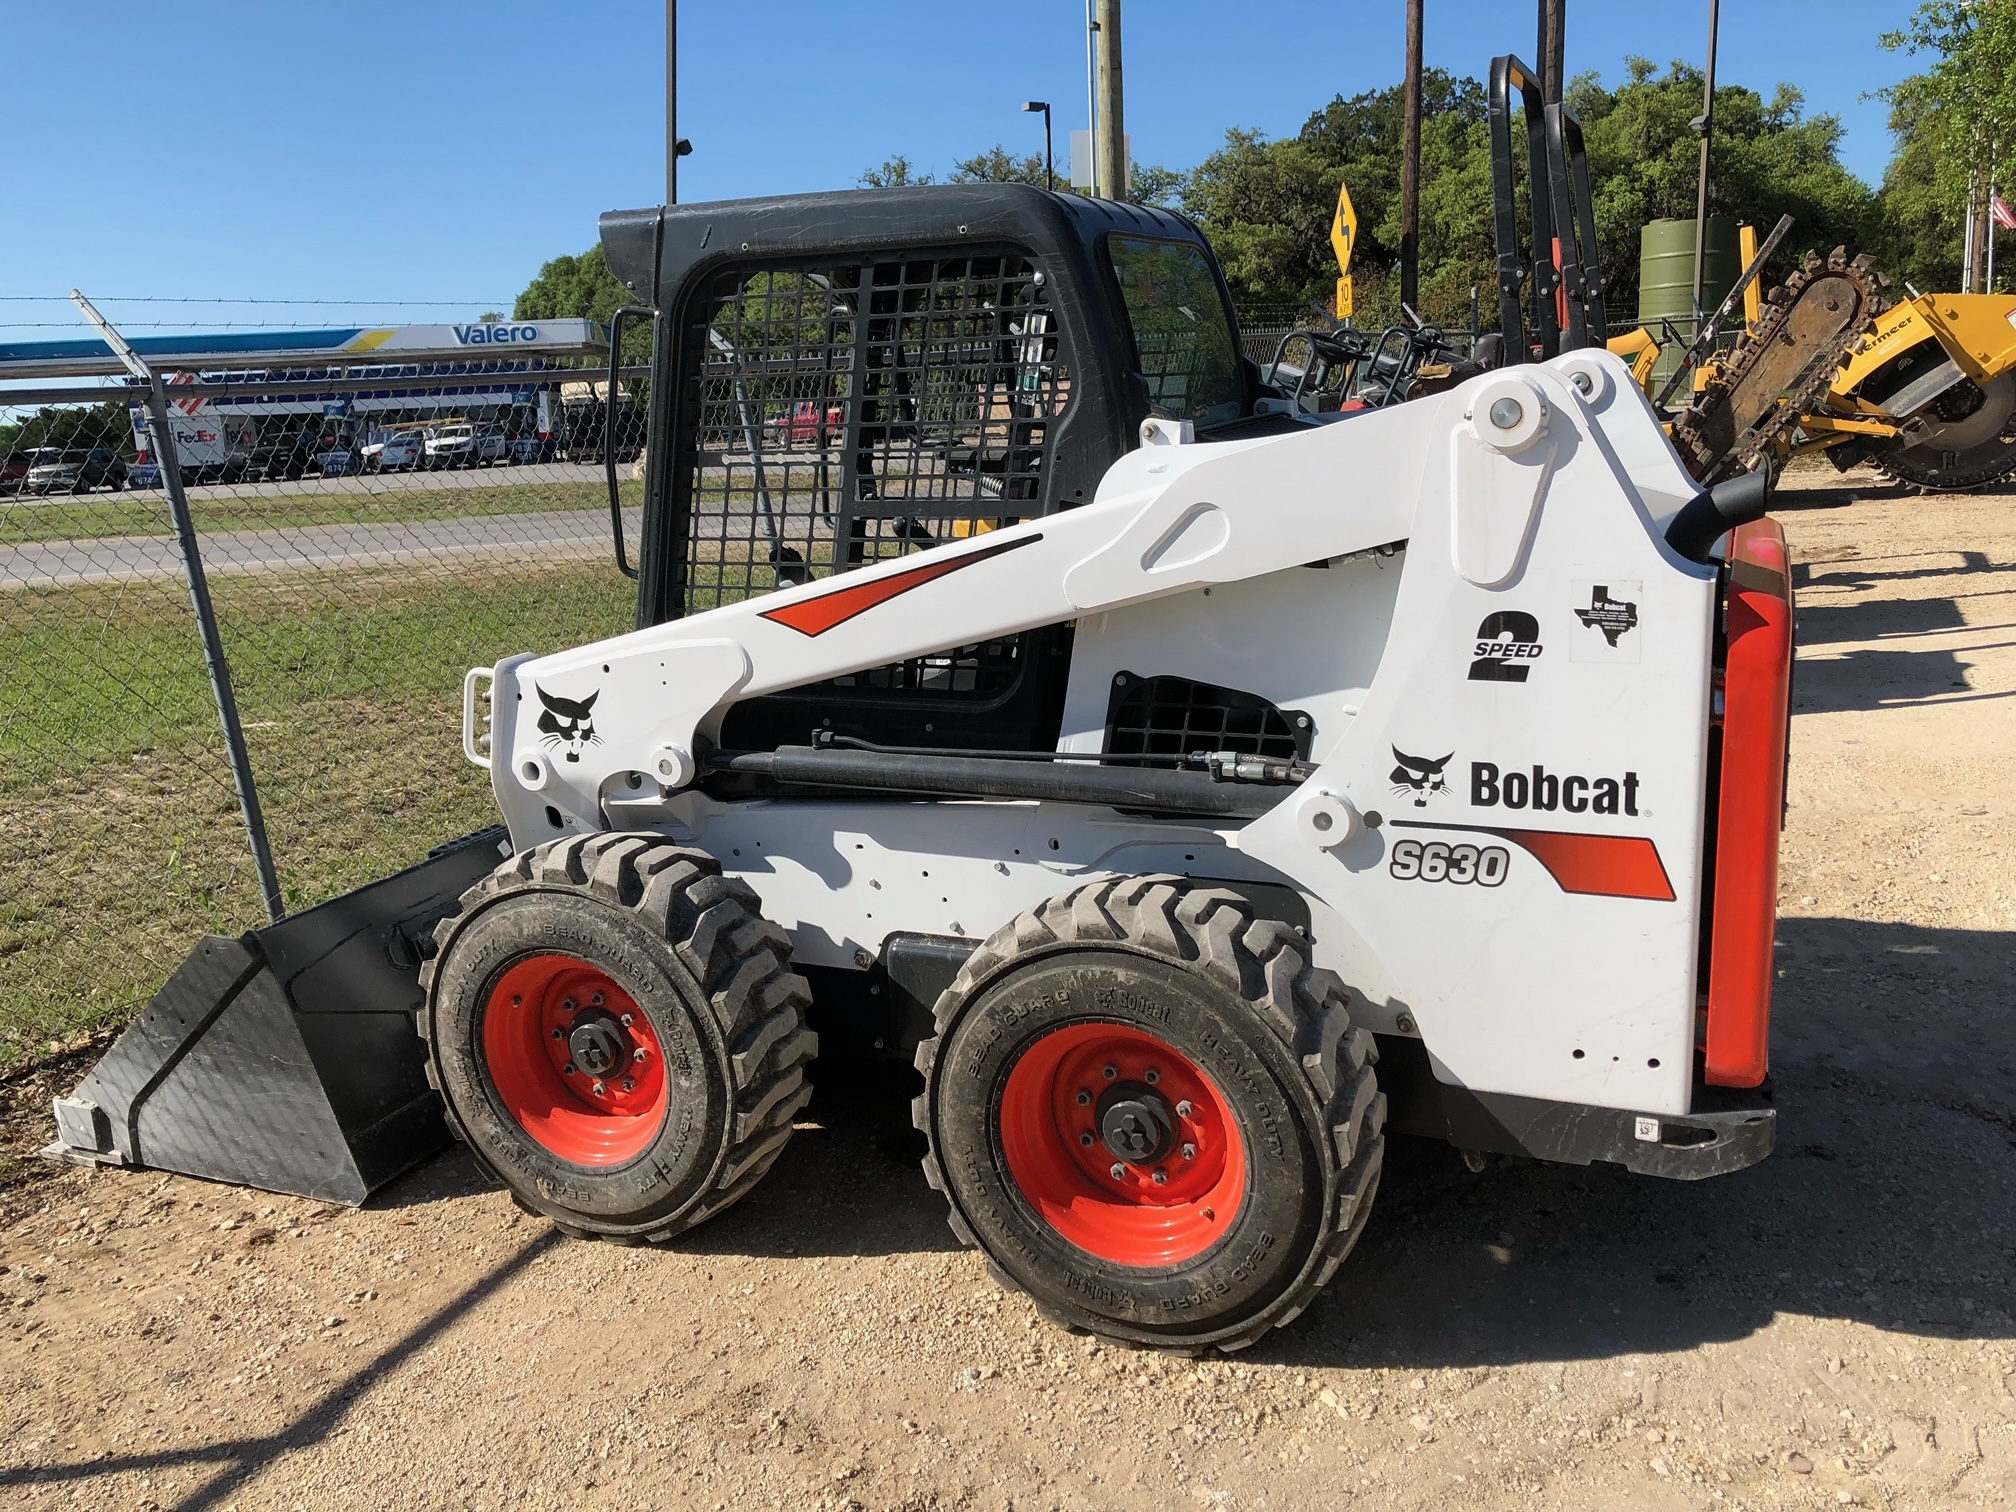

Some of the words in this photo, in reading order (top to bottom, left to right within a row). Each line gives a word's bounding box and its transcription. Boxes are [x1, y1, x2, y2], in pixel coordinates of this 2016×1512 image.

[1340, 283, 1349, 303] 10
[452, 324, 537, 345] Valero
[176, 429, 217, 443] FedEx
[1604, 603, 1626, 611] Bobcat
[1467, 610, 1539, 682] 2
[1473, 641, 1543, 659] SPEED
[1471, 761, 1639, 816] Bobcat
[1389, 839, 1510, 887] S630
[1118, 989, 1171, 1025] Bobcat
[968, 1027, 1003, 1078] BEAD
[1003, 989, 1071, 1026] GUARD
[1200, 1031, 1260, 1094] HEAVY
[1255, 1102, 1285, 1162] DUTY
[1231, 1230, 1275, 1282] BEAD
